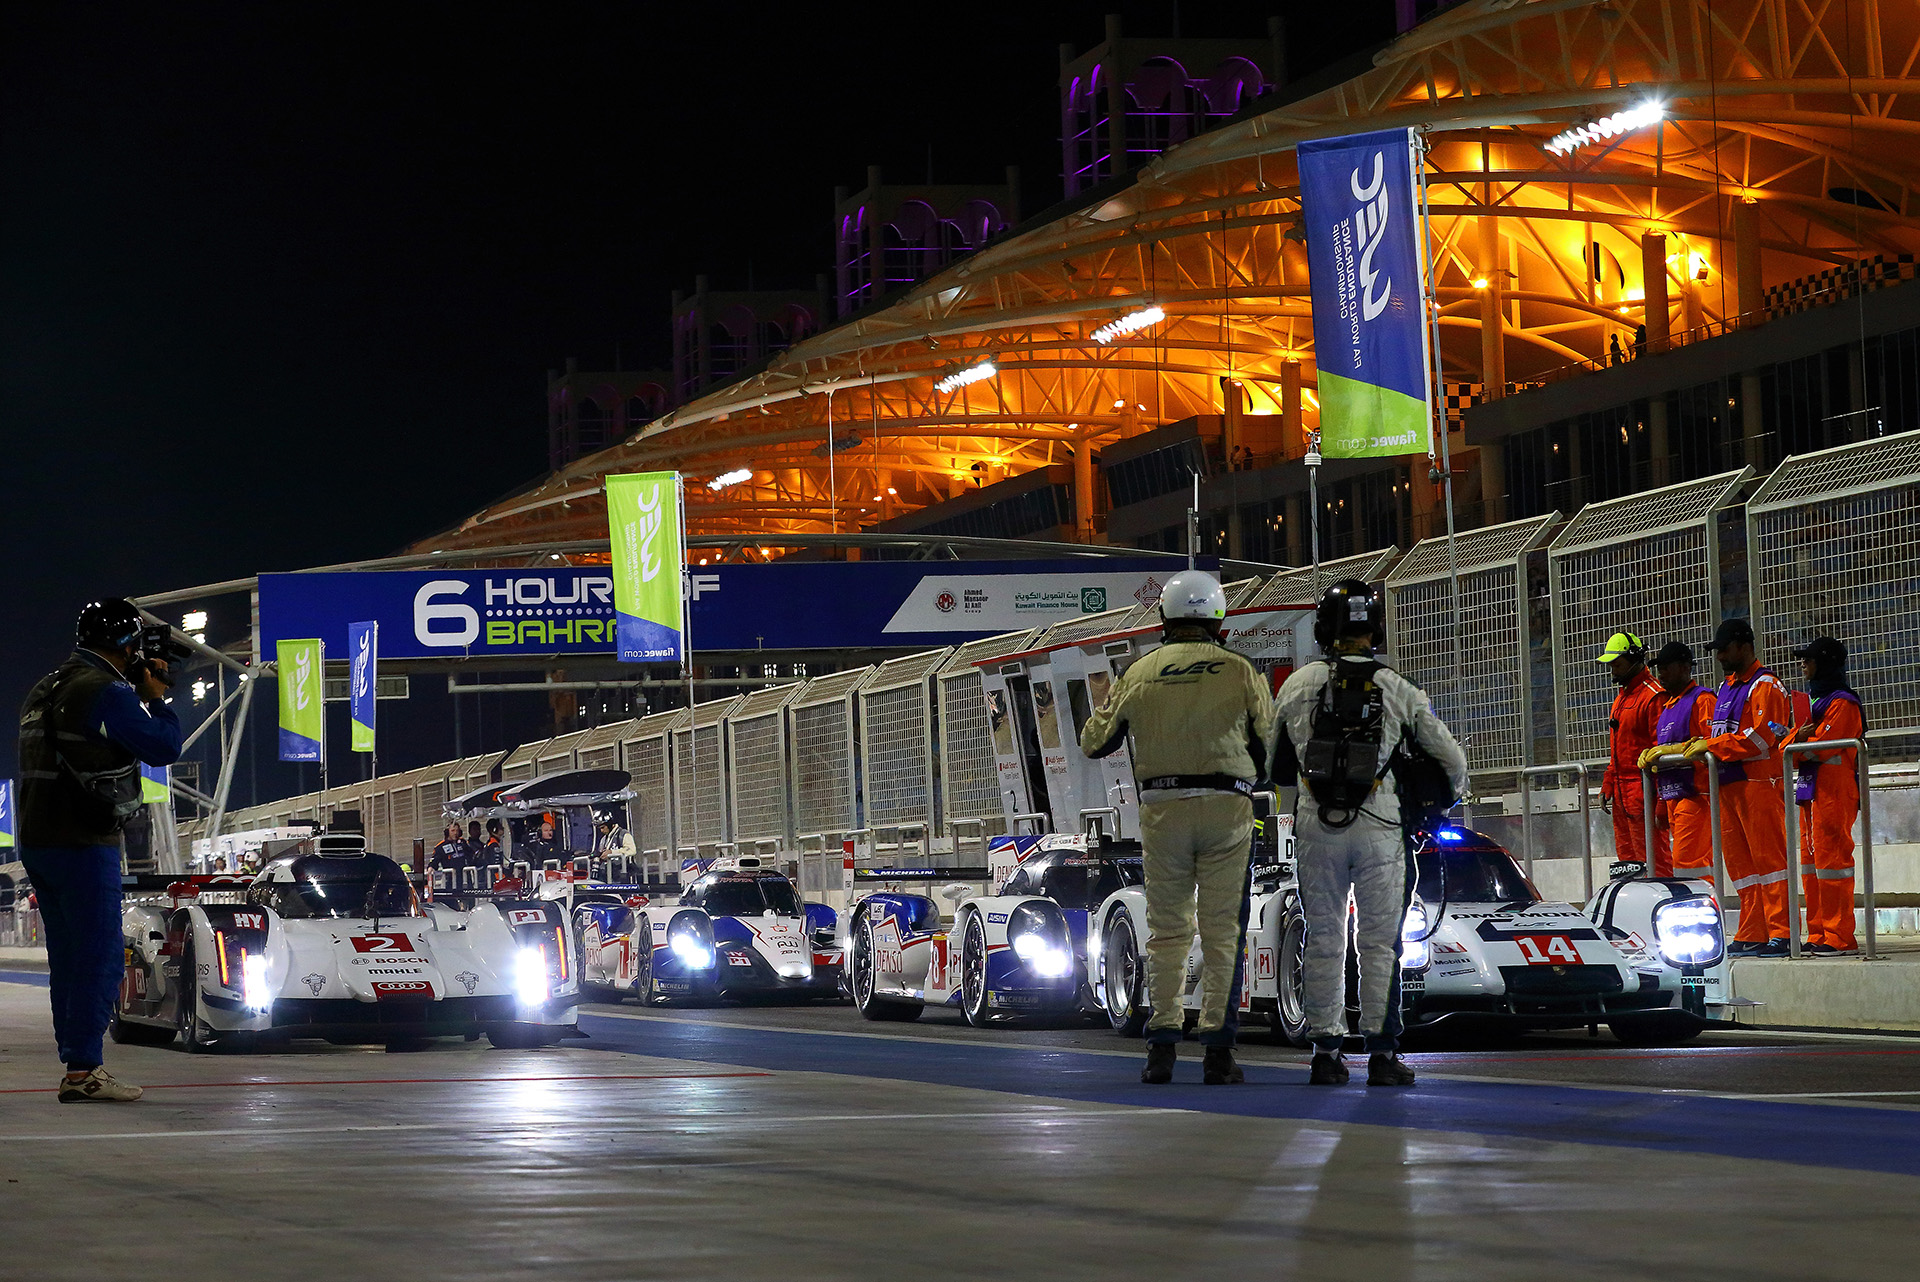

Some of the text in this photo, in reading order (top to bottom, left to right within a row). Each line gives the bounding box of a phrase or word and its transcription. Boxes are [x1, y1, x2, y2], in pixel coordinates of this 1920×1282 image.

[963, 588, 983, 596] Ahmed
[413, 579, 480, 647] 6
[485, 576, 614, 605] HOUR
[1232, 627, 1293, 639] Audi Sport
[1232, 639, 1293, 650] Team Joest
[1160, 660, 1225, 677] WEC
[235, 913, 263, 929] HY
[514, 911, 541, 922] P1
[364, 936, 401, 952] 2
[1518, 936, 1578, 963] 14
[822, 952, 843, 966] 7
[876, 950, 903, 974] DENSO
[931, 945, 940, 984] 8
[1259, 952, 1270, 975] P1
[1680, 977, 1720, 985] DMG MORI
